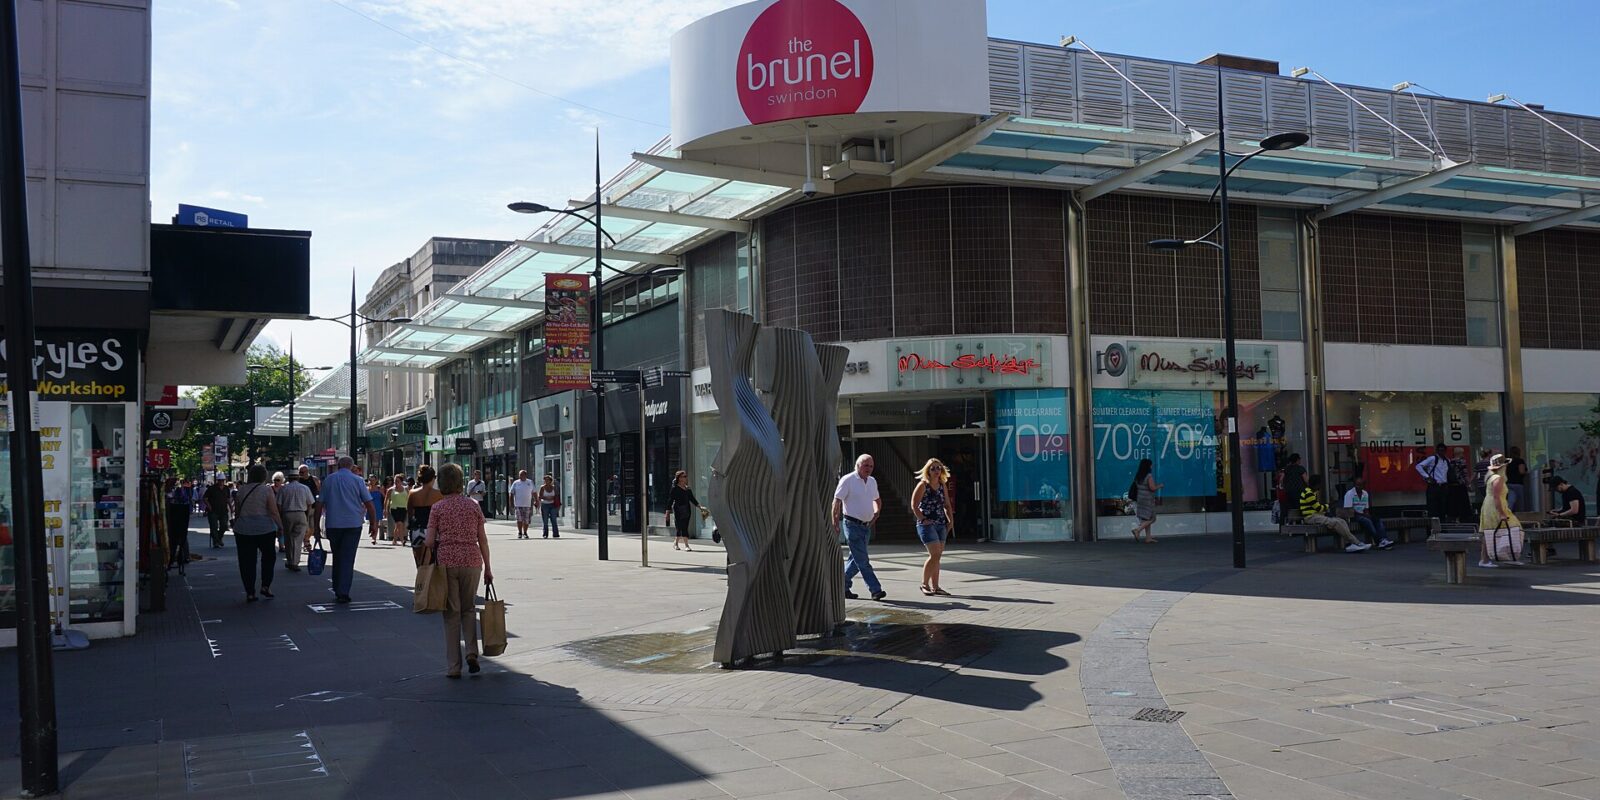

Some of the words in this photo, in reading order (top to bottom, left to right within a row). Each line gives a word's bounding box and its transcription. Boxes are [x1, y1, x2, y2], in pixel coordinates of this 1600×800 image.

[788, 37, 812, 54] the
[747, 39, 860, 91] brunel
[767, 86, 837, 106] swindon
[209, 217, 235, 227] RETAIL
[846, 361, 869, 375] SE
[898, 353, 950, 373] Miss
[951, 354, 1042, 376] Selfridge
[1141, 352, 1188, 373] Miss
[37, 381, 125, 398] Workshop
[996, 408, 1023, 416] UMMER
[1024, 407, 1062, 416] CLEARANCE
[1093, 408, 1117, 416] SUMMER
[1119, 407, 1150, 416] CLEARANCE
[1157, 408, 1181, 416] SUMMER
[1451, 414, 1462, 441] OFF
[998, 423, 1064, 462] 70%
[1094, 423, 1151, 461] 70%
[1157, 423, 1214, 460] 70%
[1370, 440, 1405, 453] OUTLET
[1042, 450, 1064, 461] OFF
[1134, 449, 1152, 460] OFF
[1195, 449, 1214, 460] OFF
